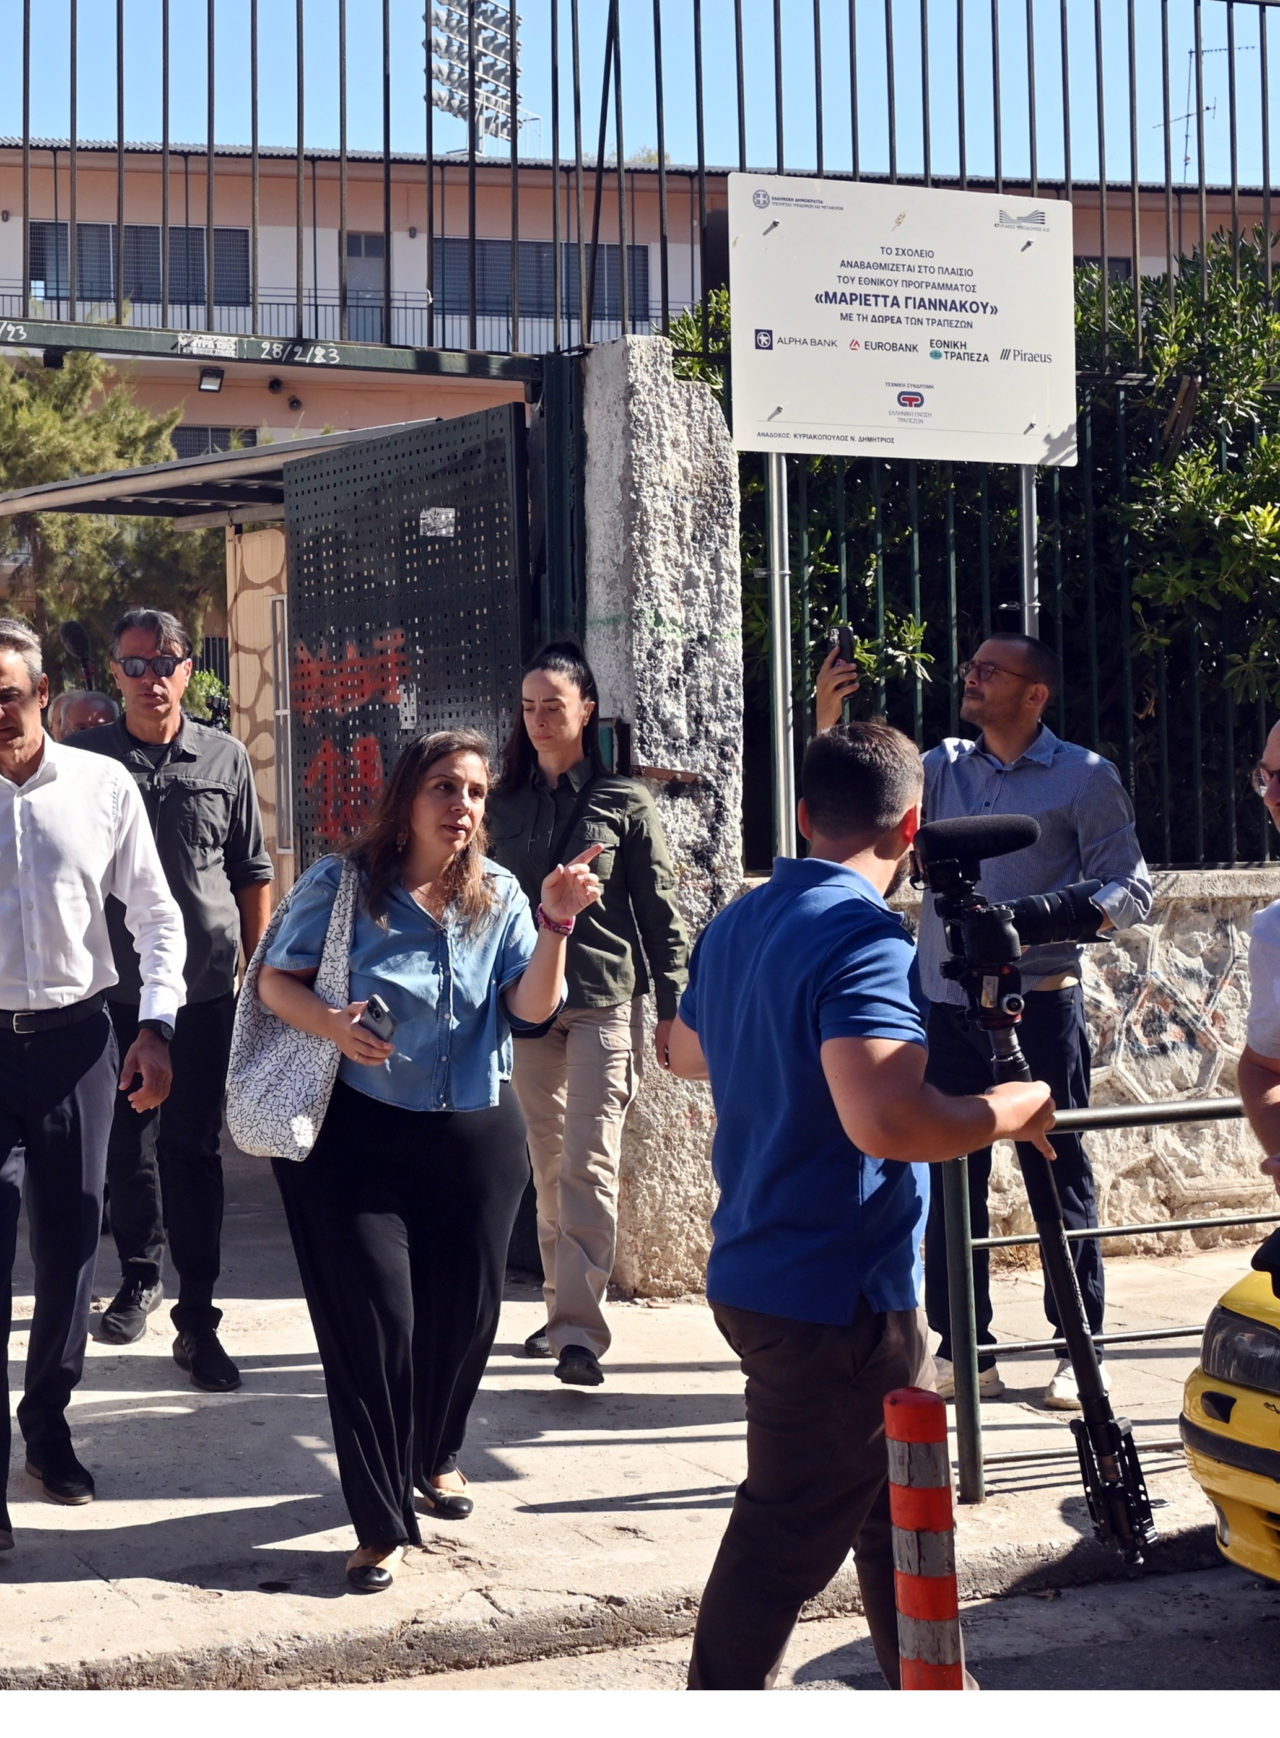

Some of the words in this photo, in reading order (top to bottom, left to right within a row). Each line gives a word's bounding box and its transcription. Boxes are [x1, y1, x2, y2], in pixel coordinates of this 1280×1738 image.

[880, 246, 893, 256] ΤΟ
[895, 247, 935, 259] ΣΧΟΛΕΙΟ
[840, 259, 916, 273] ΑΝΑΒΑΘΜΙΖΕΤΑΙ
[917, 264, 936, 275] ΣΤΟ
[937, 266, 974, 277] ΠΛΑΙΣΙΟ
[836, 275, 856, 285] ΤΟΥ
[858, 276, 899, 288] ΕΘΝΙΚΟΥ
[901, 279, 977, 293] ΠΡΟΓΡΑΜΜΑΤΟΣ
[814, 290, 901, 309] «ΜΑΡΙΕΤΤΑ
[904, 296, 999, 316] ΓΙΑΝΝΑΚΟΥ»
[840, 312, 854, 322] ΜΕ
[856, 313, 869, 323] ΤΗ
[870, 314, 903, 325] ΔΩΡΕΑ
[904, 316, 924, 326] ΤΩΝ
[925, 317, 973, 329] ΤΡΑΠΕΖΩΝ
[776, 336, 808, 346] ALPHA
[810, 338, 838, 348] BANK
[864, 340, 919, 353] EUROBANK
[929, 339, 967, 350] ΕΘΝΙΚΗ
[943, 350, 990, 363] ΤΡΑΠΕΖΑ
[1013, 348, 1053, 364] Piraeus
[756, 431, 791, 439] ΑΝΑΔΟΧΟΣ:
[793, 432, 849, 442] ΚΥΡΙΑΚΟΠΟΥΛΟΣ
[857, 436, 895, 444] ΔΗΜΗΤΡΙΟΣ
